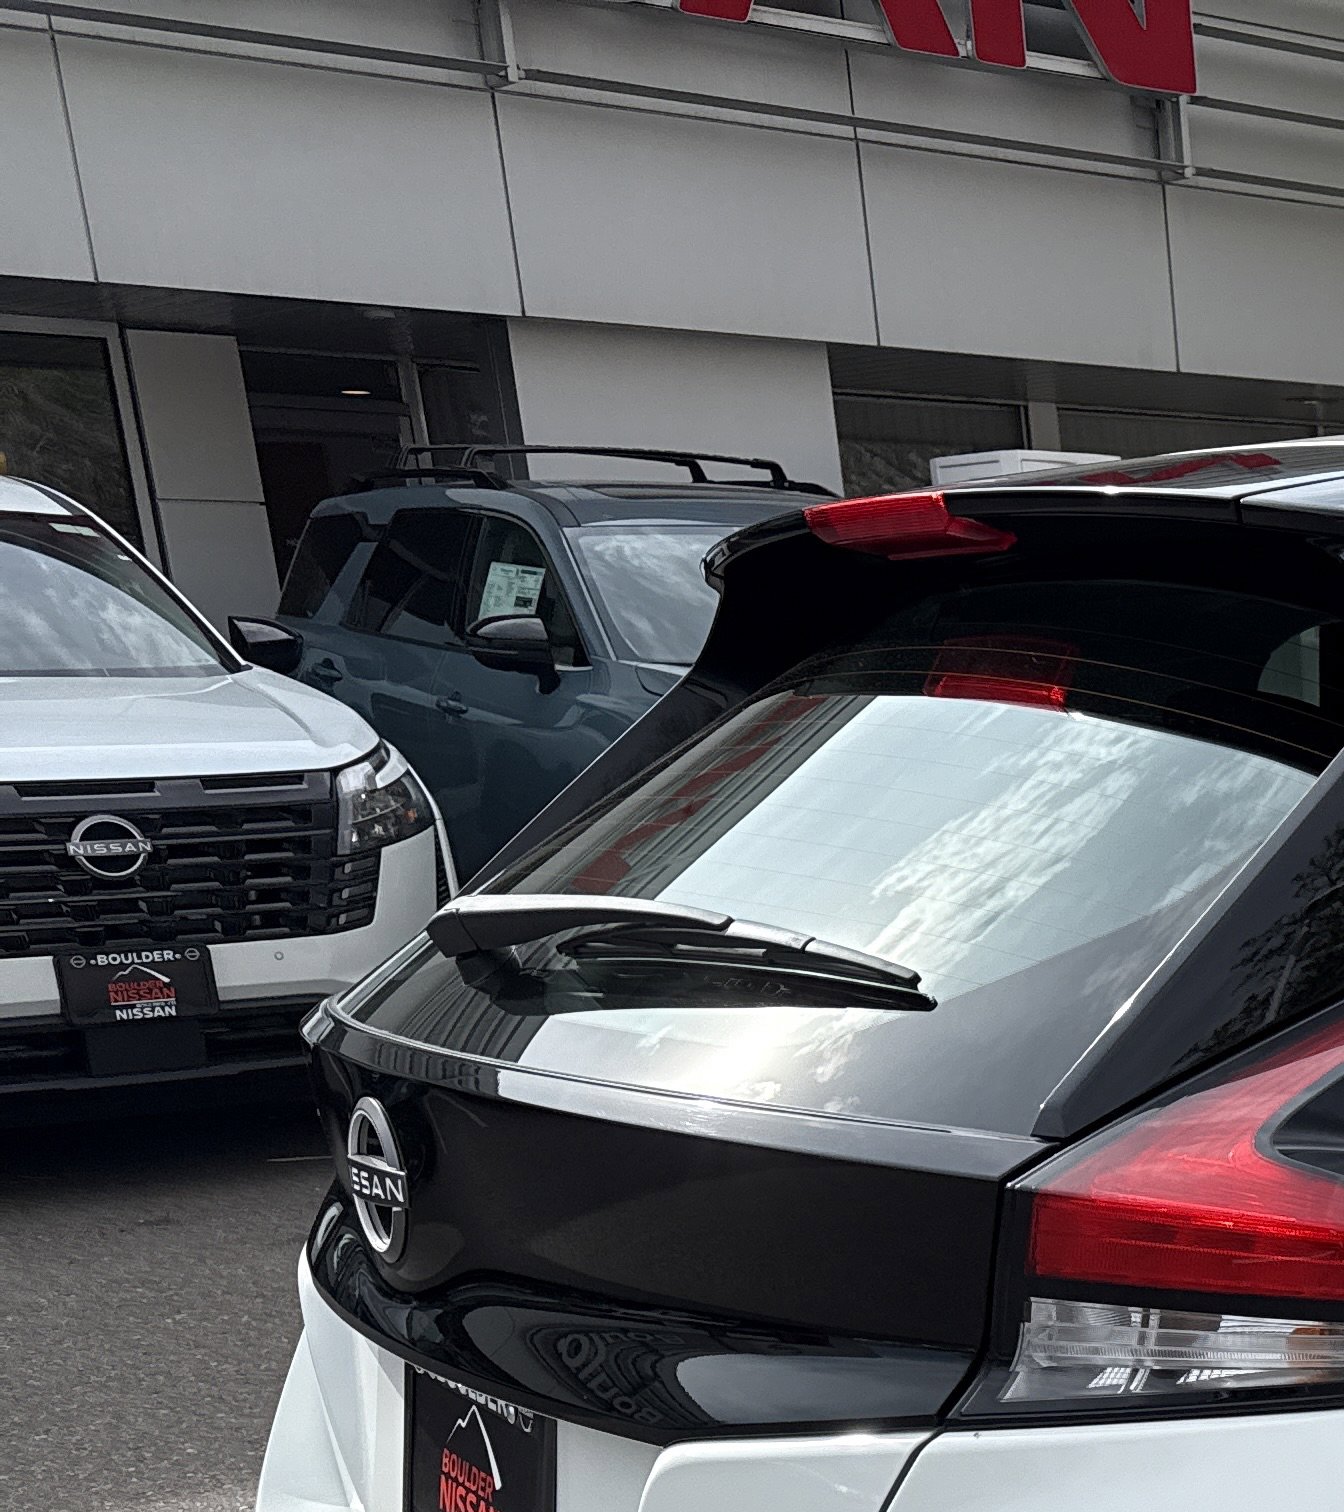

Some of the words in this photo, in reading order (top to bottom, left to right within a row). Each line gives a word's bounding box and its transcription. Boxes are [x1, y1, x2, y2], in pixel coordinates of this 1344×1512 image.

[69, 841, 152, 856] NISSAN
[97, 950, 174, 965] BOULDER
[108, 980, 164, 992] BOULDER
[109, 987, 176, 1003] NISSAN
[115, 1005, 177, 1020] NISSAN
[352, 1167, 405, 1203] SSAN
[440, 1447, 494, 1502] BOULDER
